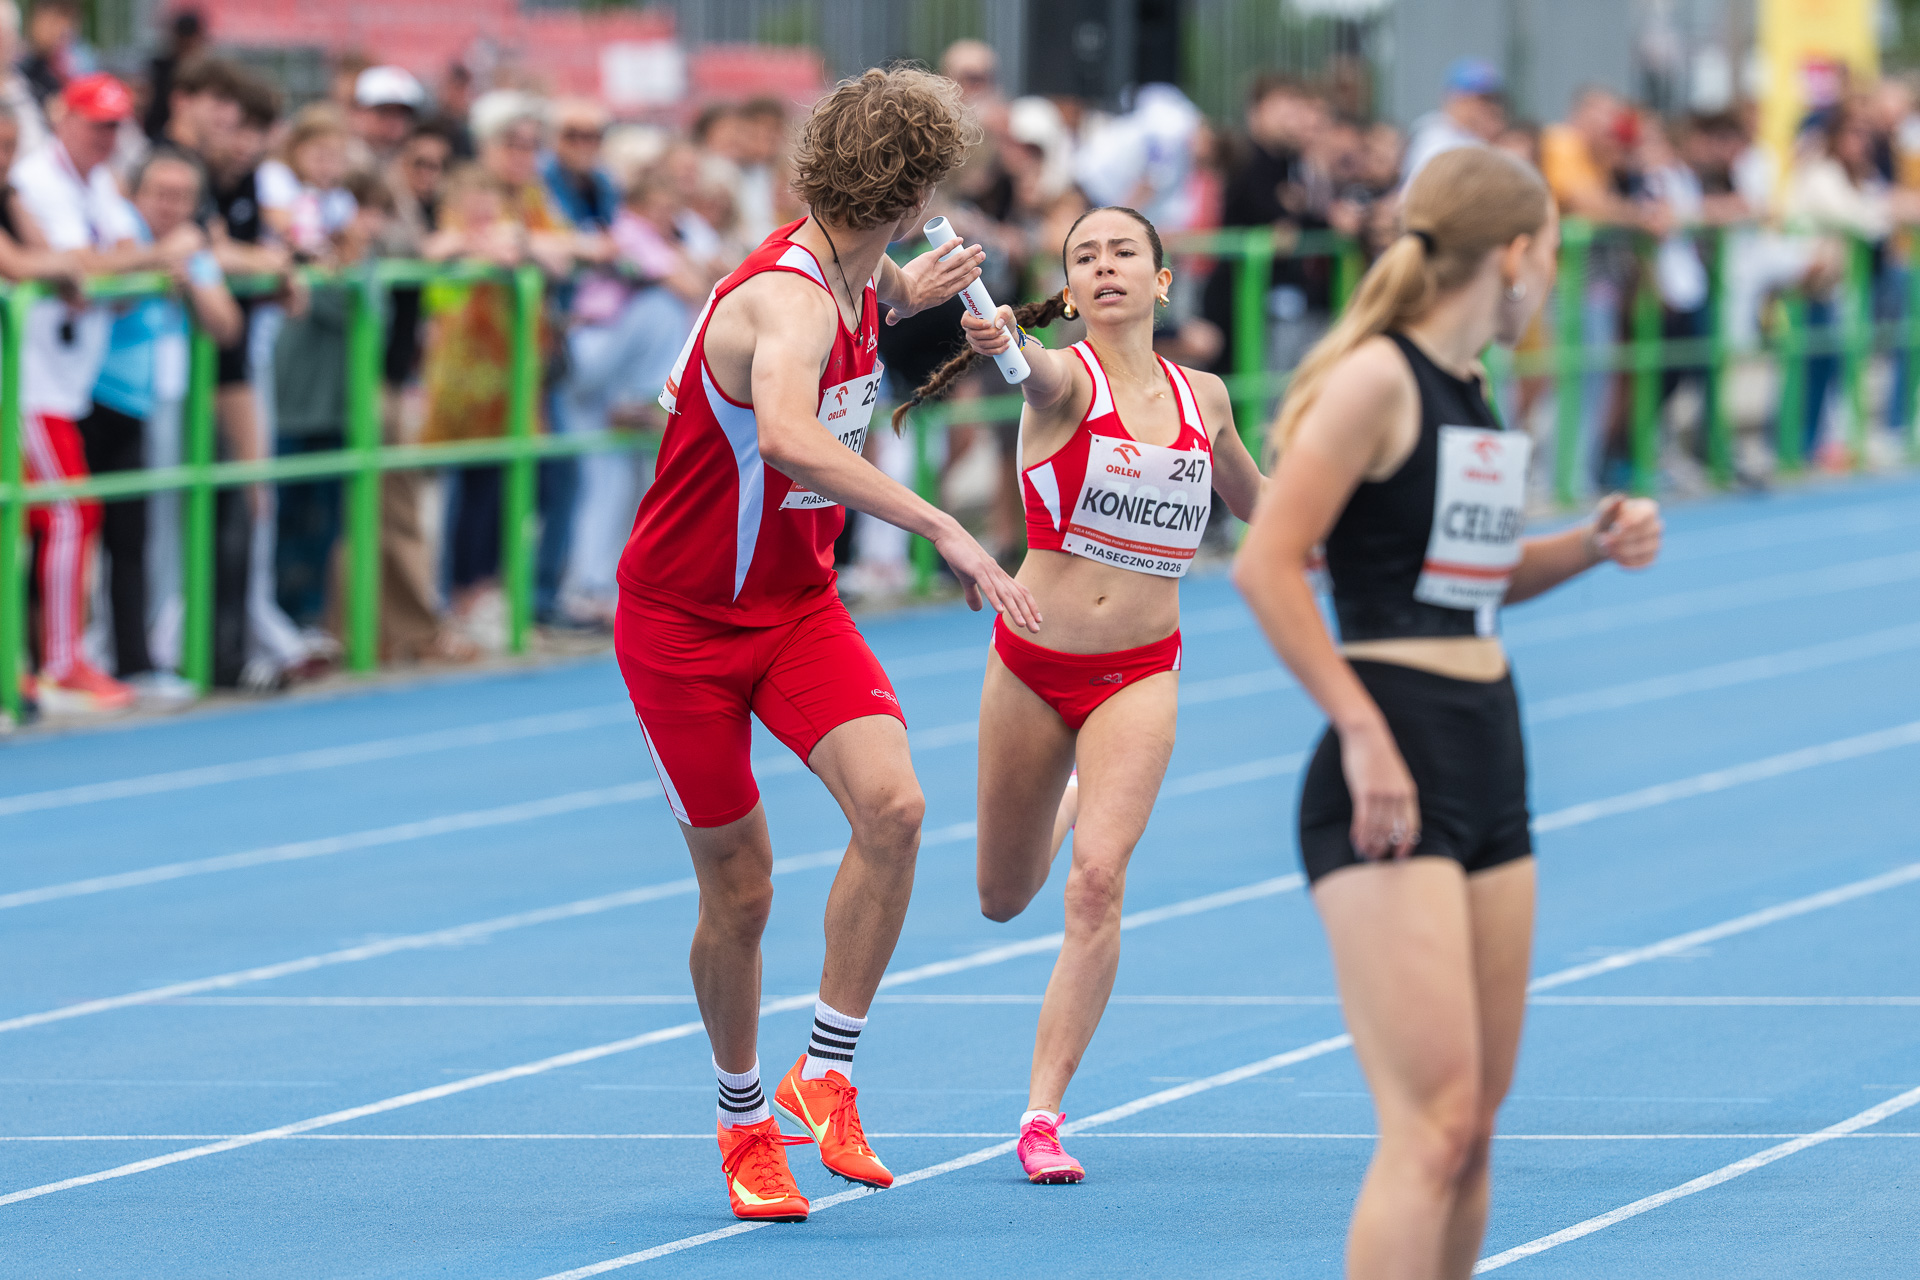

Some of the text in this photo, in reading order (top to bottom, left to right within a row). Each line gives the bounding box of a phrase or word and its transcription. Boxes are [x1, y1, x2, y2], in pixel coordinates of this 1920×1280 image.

[828, 408, 848, 422] ORLEN
[1105, 464, 1142, 479] ORLEN
[1168, 458, 1206, 483] 247
[1081, 487, 1207, 532] KONIECZNY
[1084, 543, 1182, 573] PIASECZNO 2026
